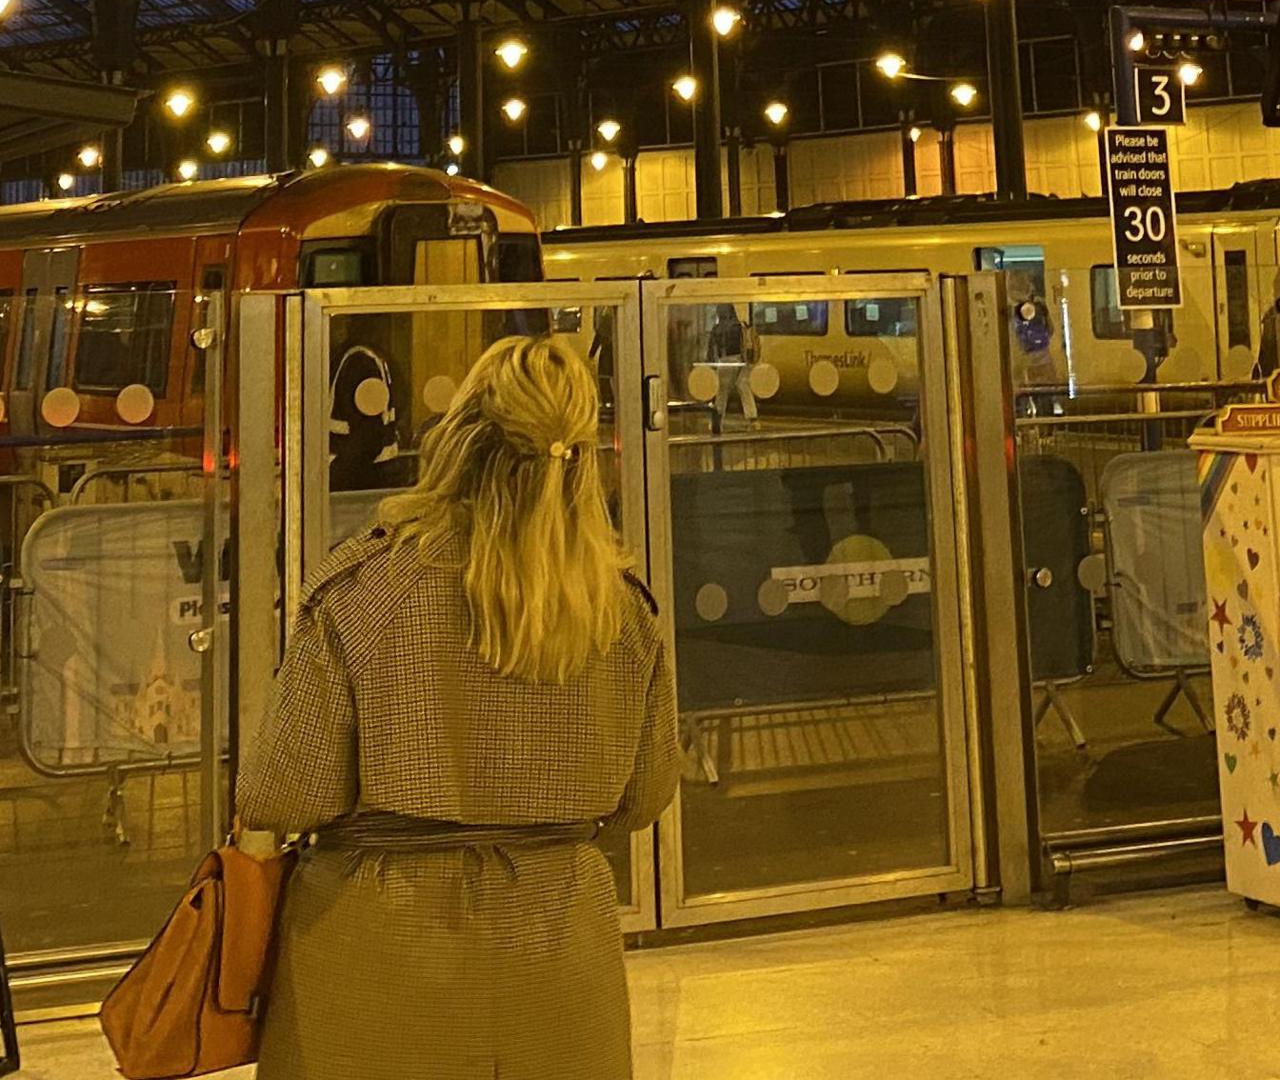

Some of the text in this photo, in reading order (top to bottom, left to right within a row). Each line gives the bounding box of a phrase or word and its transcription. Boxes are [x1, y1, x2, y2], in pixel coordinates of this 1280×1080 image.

[1151, 75, 1171, 116] 3
[1115, 135, 1159, 148] Please be
[1111, 151, 1167, 164] advised that
[1115, 169, 1166, 181] train doors
[1120, 185, 1163, 197] will close
[1124, 206, 1166, 242] 30
[1127, 252, 1166, 265] seconds
[1130, 269, 1167, 283] prior to
[1126, 285, 1174, 300] departure
